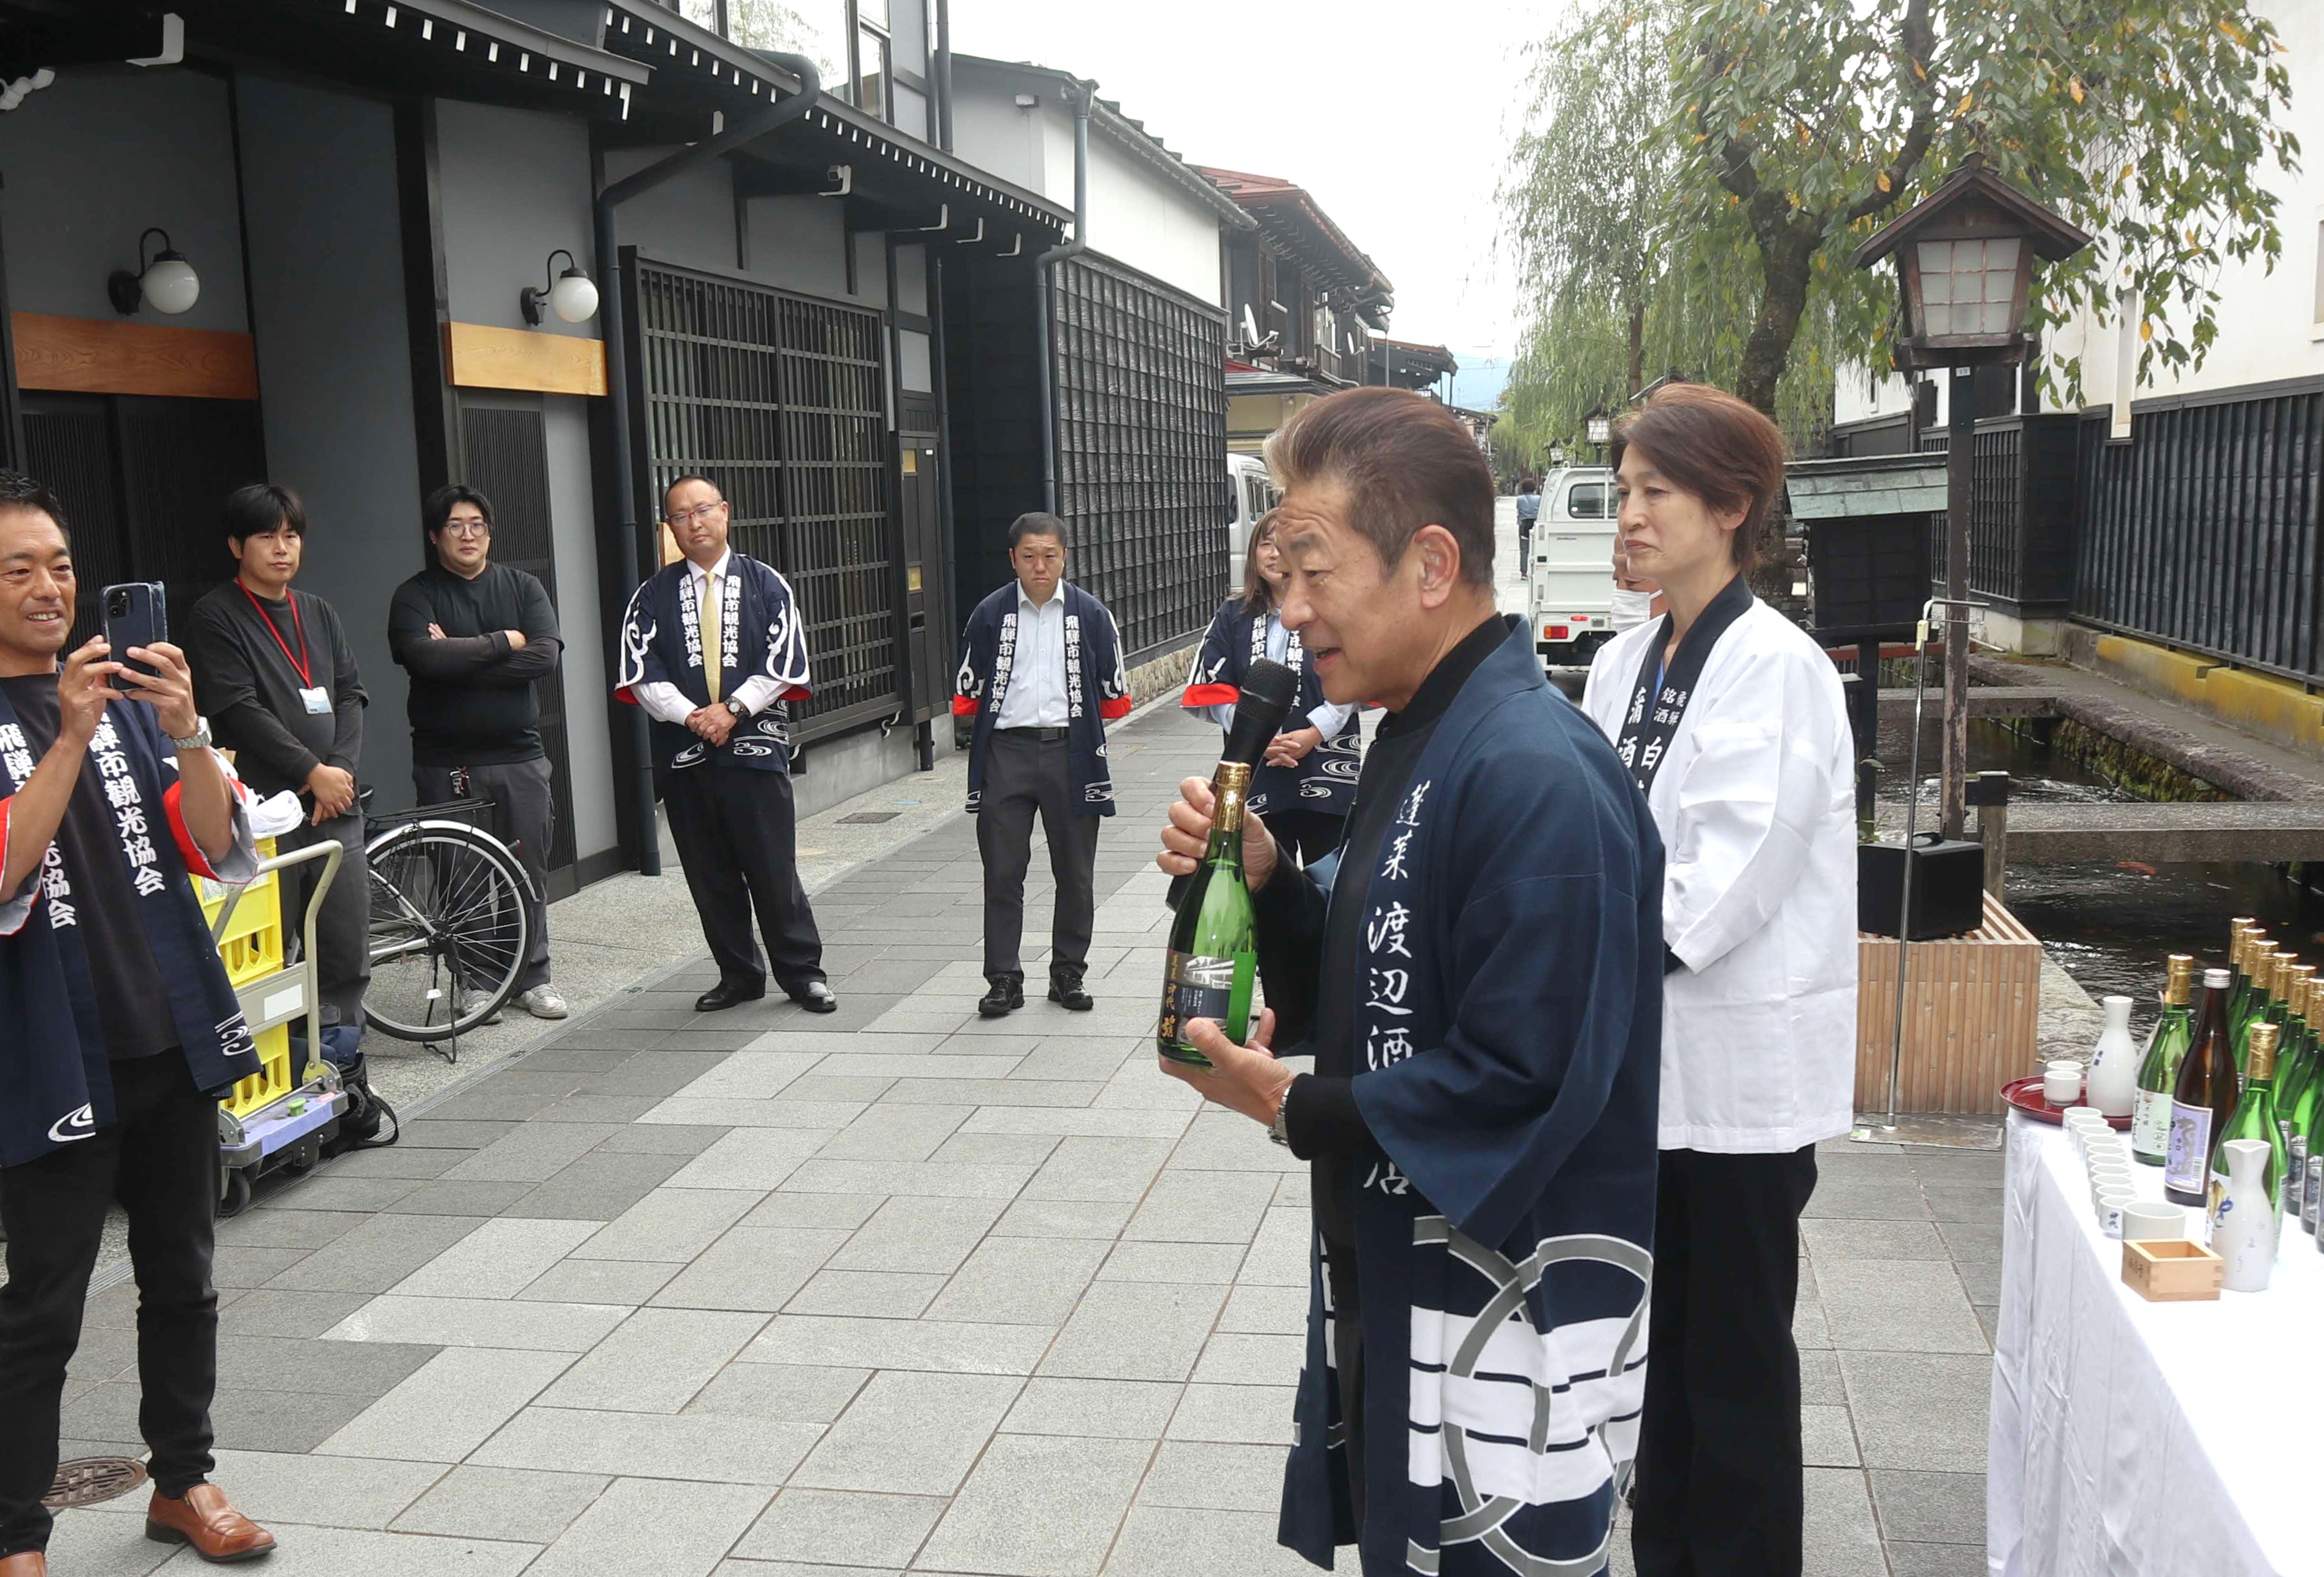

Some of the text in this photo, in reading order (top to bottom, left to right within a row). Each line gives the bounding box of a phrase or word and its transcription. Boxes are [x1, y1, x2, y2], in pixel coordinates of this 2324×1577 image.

[679, 573, 703, 668] 飛騨市観光協会
[722, 575, 742, 668] 飛騨市観光協会
[989, 613, 1017, 713] 飛騨市観光協会
[1065, 615, 1083, 718] 飛騨市観光協会
[1653, 687, 1677, 724] 銘酒
[88, 712, 165, 896] 騨市観光協会
[1638, 736, 1662, 789] 白
[1363, 901, 1414, 1195] 渡辺酒店
